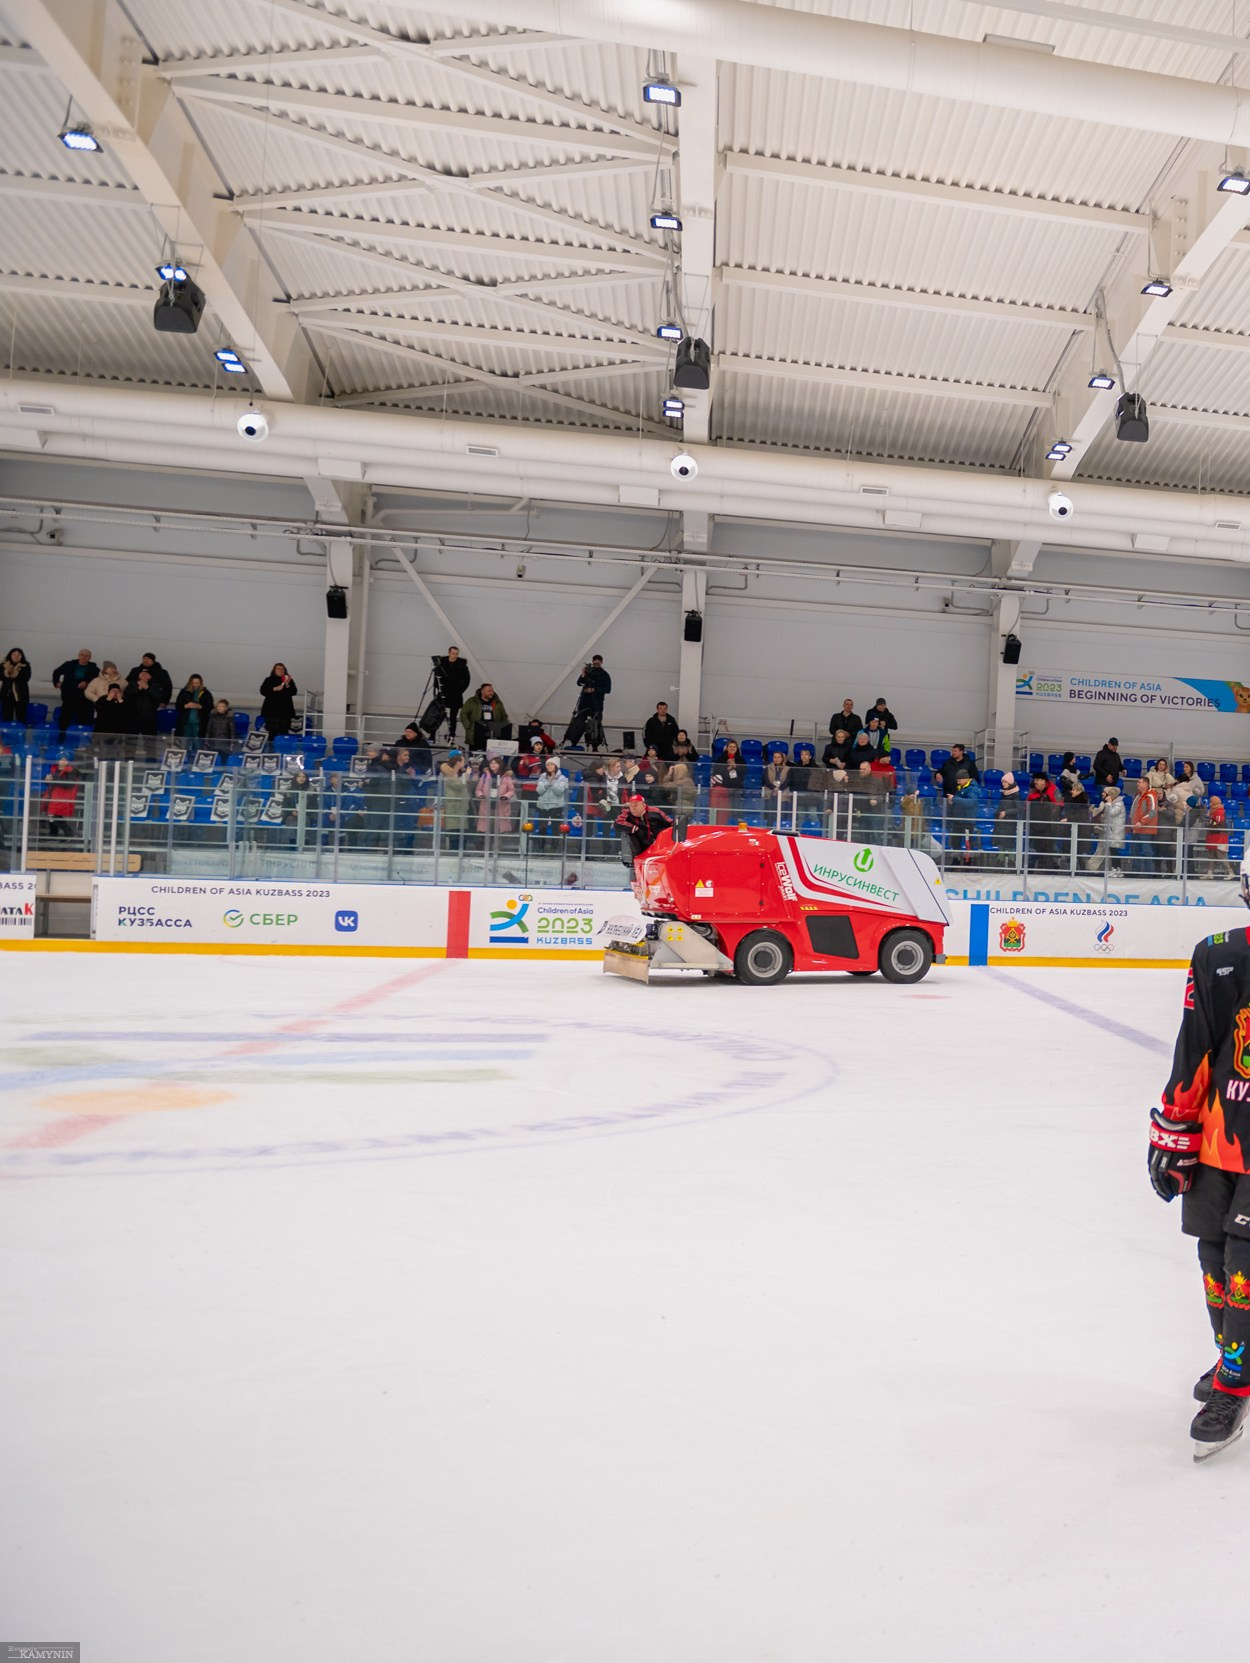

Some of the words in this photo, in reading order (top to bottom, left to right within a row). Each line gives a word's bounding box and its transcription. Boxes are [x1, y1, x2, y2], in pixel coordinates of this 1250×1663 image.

[1036, 683, 1062, 692] 2023
[1070, 677, 1122, 689] CHILDREN
[1123, 680, 1138, 690] OF
[1140, 682, 1162, 692] ASIA
[1069, 690, 1138, 703] BEGINNING
[1140, 694, 1157, 704] OF
[1160, 695, 1221, 708] VICTORIES
[813, 864, 900, 902] ИНРУСИНВЕСТ
[151, 886, 206, 895] CHILDREN
[207, 887, 225, 895] OF
[228, 888, 252, 896] ASIA
[256, 889, 303, 897] KUZBASS
[306, 890, 330, 898] 2023
[118, 906, 156, 917] РЦСС
[537, 906, 568, 914] Children
[990, 907, 1032, 915] CHILDREN
[1048, 908, 1068, 916] ASIA
[1070, 909, 1106, 917] KUZBASS
[118, 918, 192, 928] КУЗБАССА
[250, 913, 298, 926] СБЕР
[338, 916, 355, 927] VK
[537, 917, 593, 934] 2023
